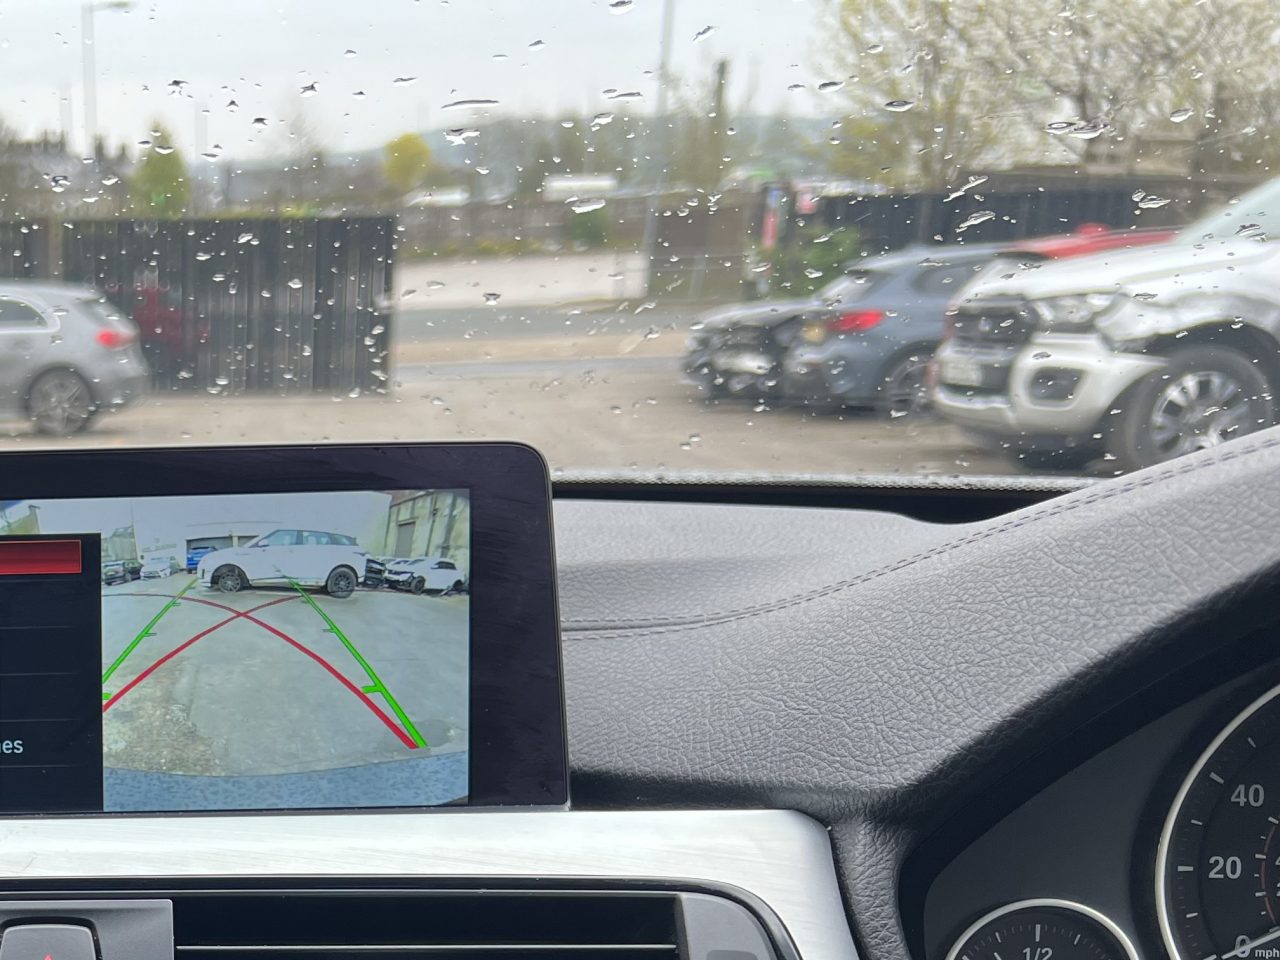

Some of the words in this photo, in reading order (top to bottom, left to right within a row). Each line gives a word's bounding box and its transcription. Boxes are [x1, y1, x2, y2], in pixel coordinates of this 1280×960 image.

[1230, 783, 1265, 807] 40
[1208, 855, 1242, 879] 20
[1255, 948, 1280, 960] mph
